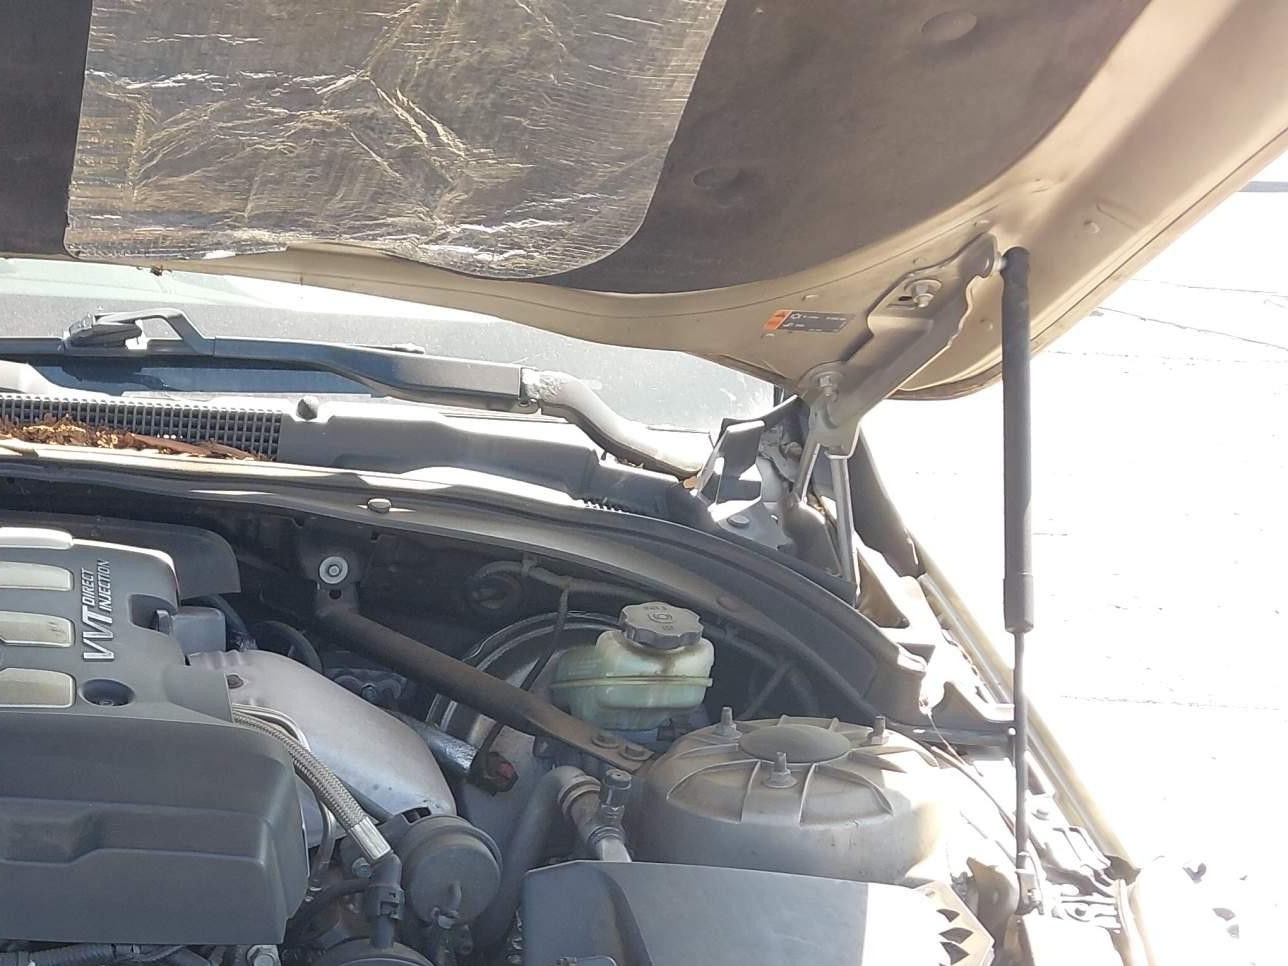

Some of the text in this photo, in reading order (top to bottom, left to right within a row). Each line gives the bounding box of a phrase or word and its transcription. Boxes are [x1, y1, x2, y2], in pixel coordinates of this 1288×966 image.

[81, 567, 95, 606] DIRECT
[97, 559, 112, 612] INJECTION
[83, 605, 114, 659] VVT
